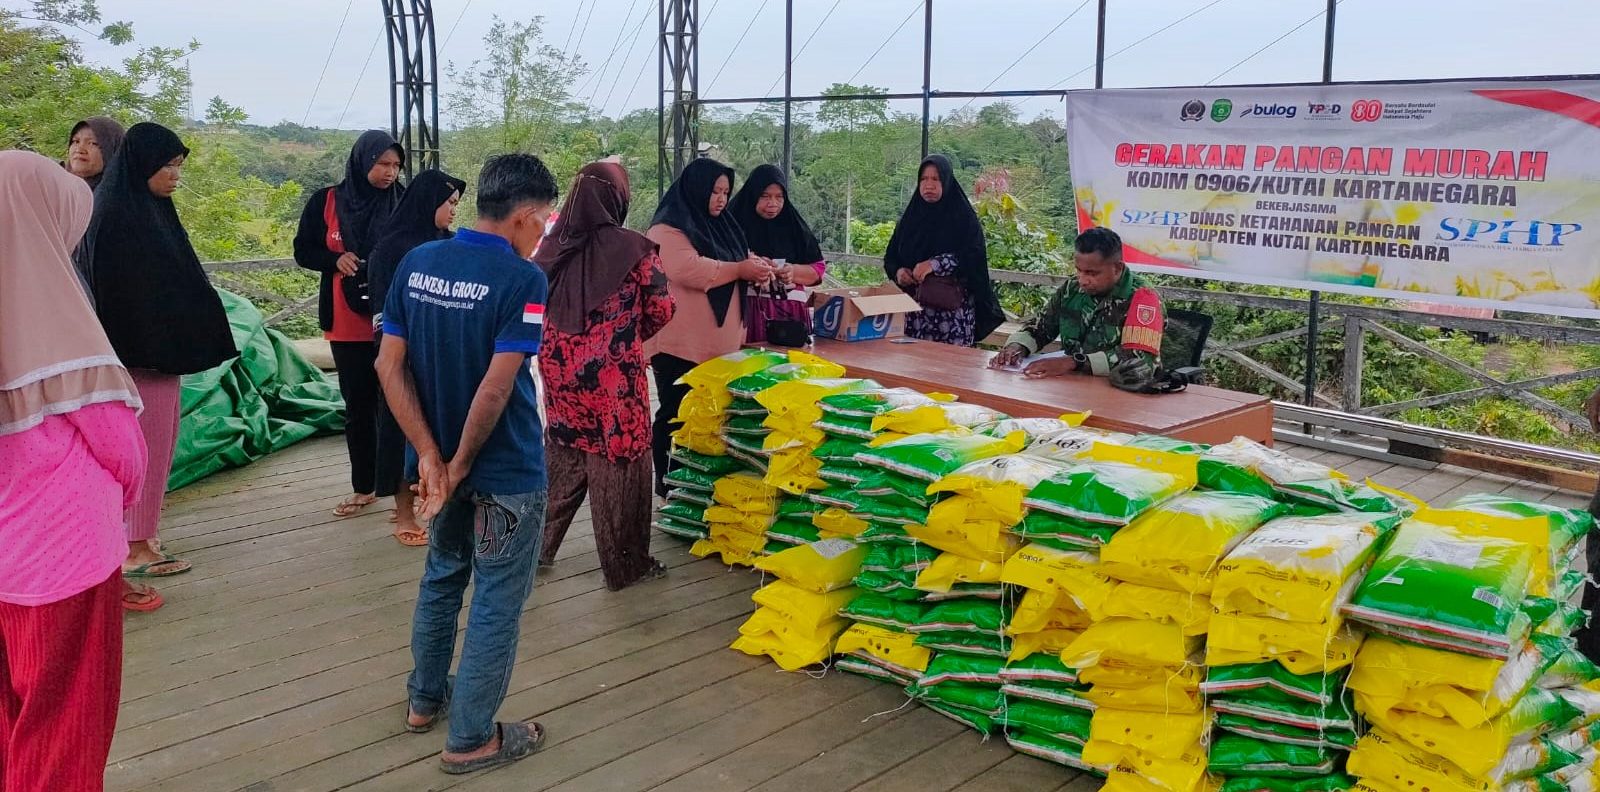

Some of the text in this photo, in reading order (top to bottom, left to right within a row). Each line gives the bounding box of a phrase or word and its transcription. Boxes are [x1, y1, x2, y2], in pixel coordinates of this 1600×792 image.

[1253, 103, 1297, 119] bulog
[1351, 100, 1383, 122] 80
[1114, 142, 1549, 182] GERAKAN PANGAN MURAH
[1126, 170, 1517, 207] KODIM 0906/KUTAI KARTANEGARA
[1120, 208, 1188, 226] SPHP
[1255, 200, 1338, 215] BEKERJASAMA
[1189, 211, 1421, 241] DINAS KETAHANAN PANGAN
[1435, 217, 1583, 247] SPHP
[1169, 226, 1257, 246] KABUPATEN
[1262, 233, 1310, 251] KUTAI
[1315, 236, 1450, 263] KARTANEGARA
[451, 281, 489, 301] GROUP
